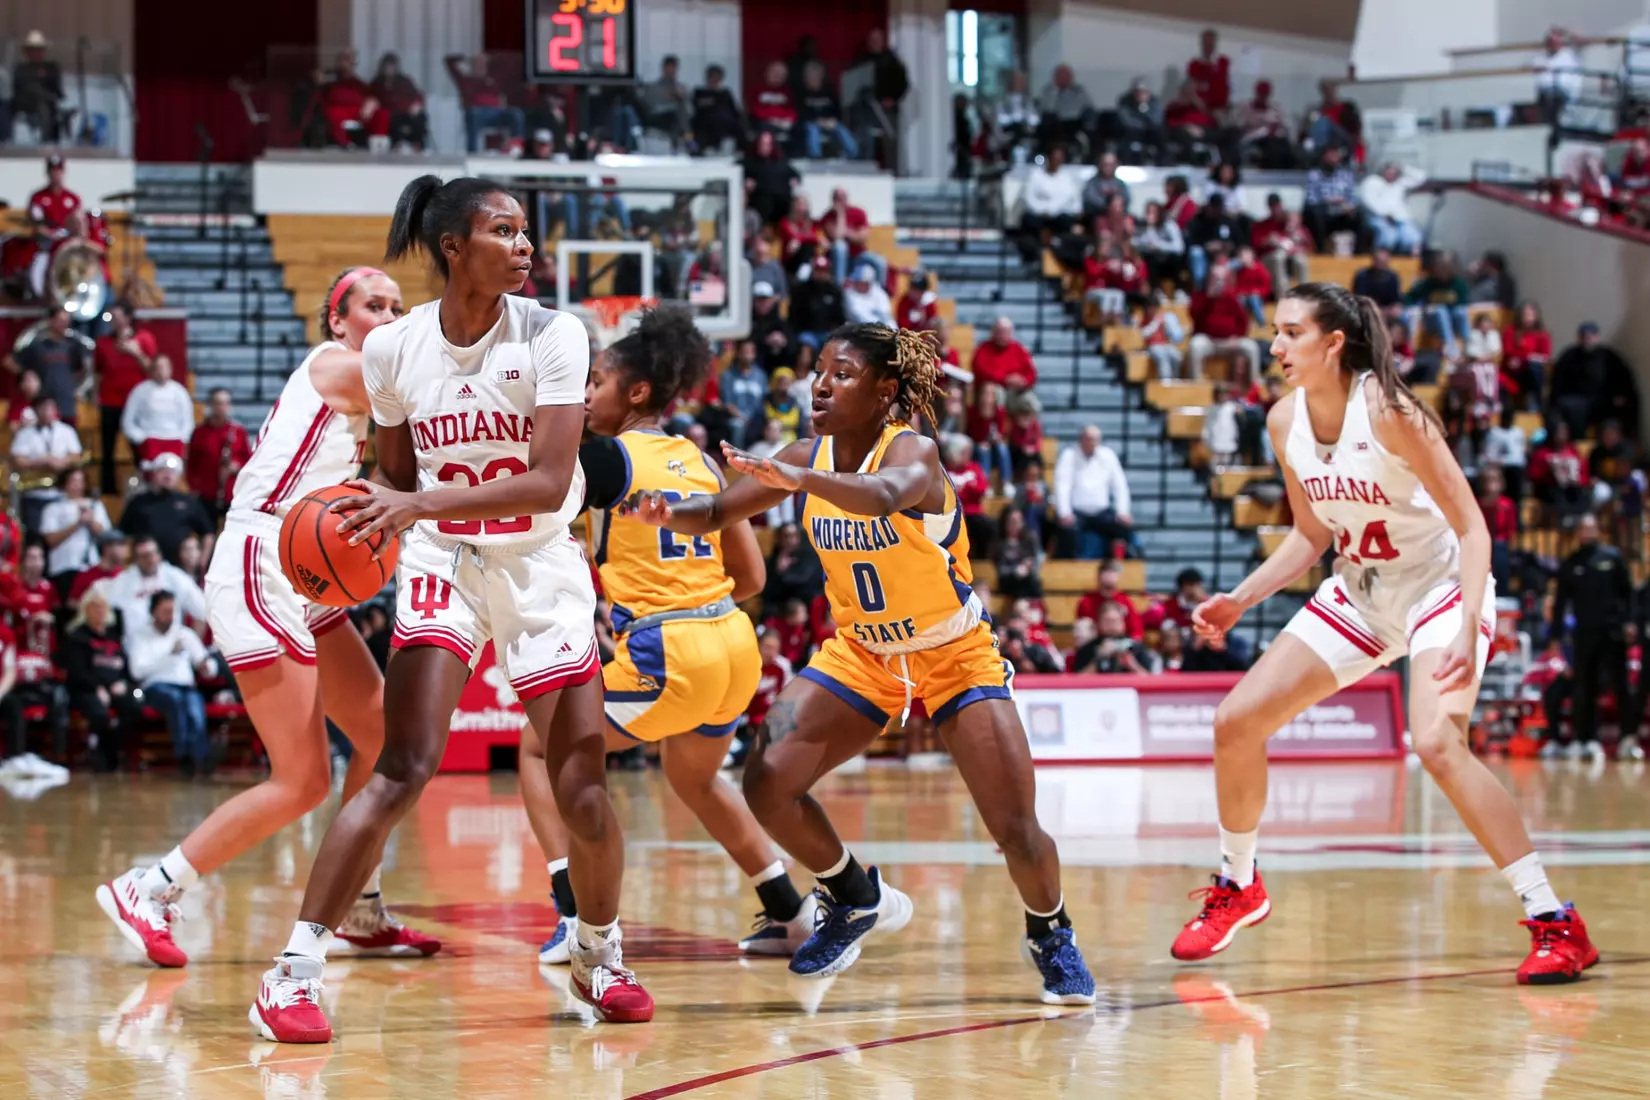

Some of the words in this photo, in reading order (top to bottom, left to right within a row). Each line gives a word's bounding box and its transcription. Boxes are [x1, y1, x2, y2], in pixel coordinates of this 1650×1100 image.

[548, 13, 616, 71] 21
[1304, 475, 1392, 506] NDIANA
[811, 515, 900, 551] MOREHEAD
[296, 564, 321, 600] adidas
[851, 562, 886, 614] 0
[853, 617, 916, 643] STATE
